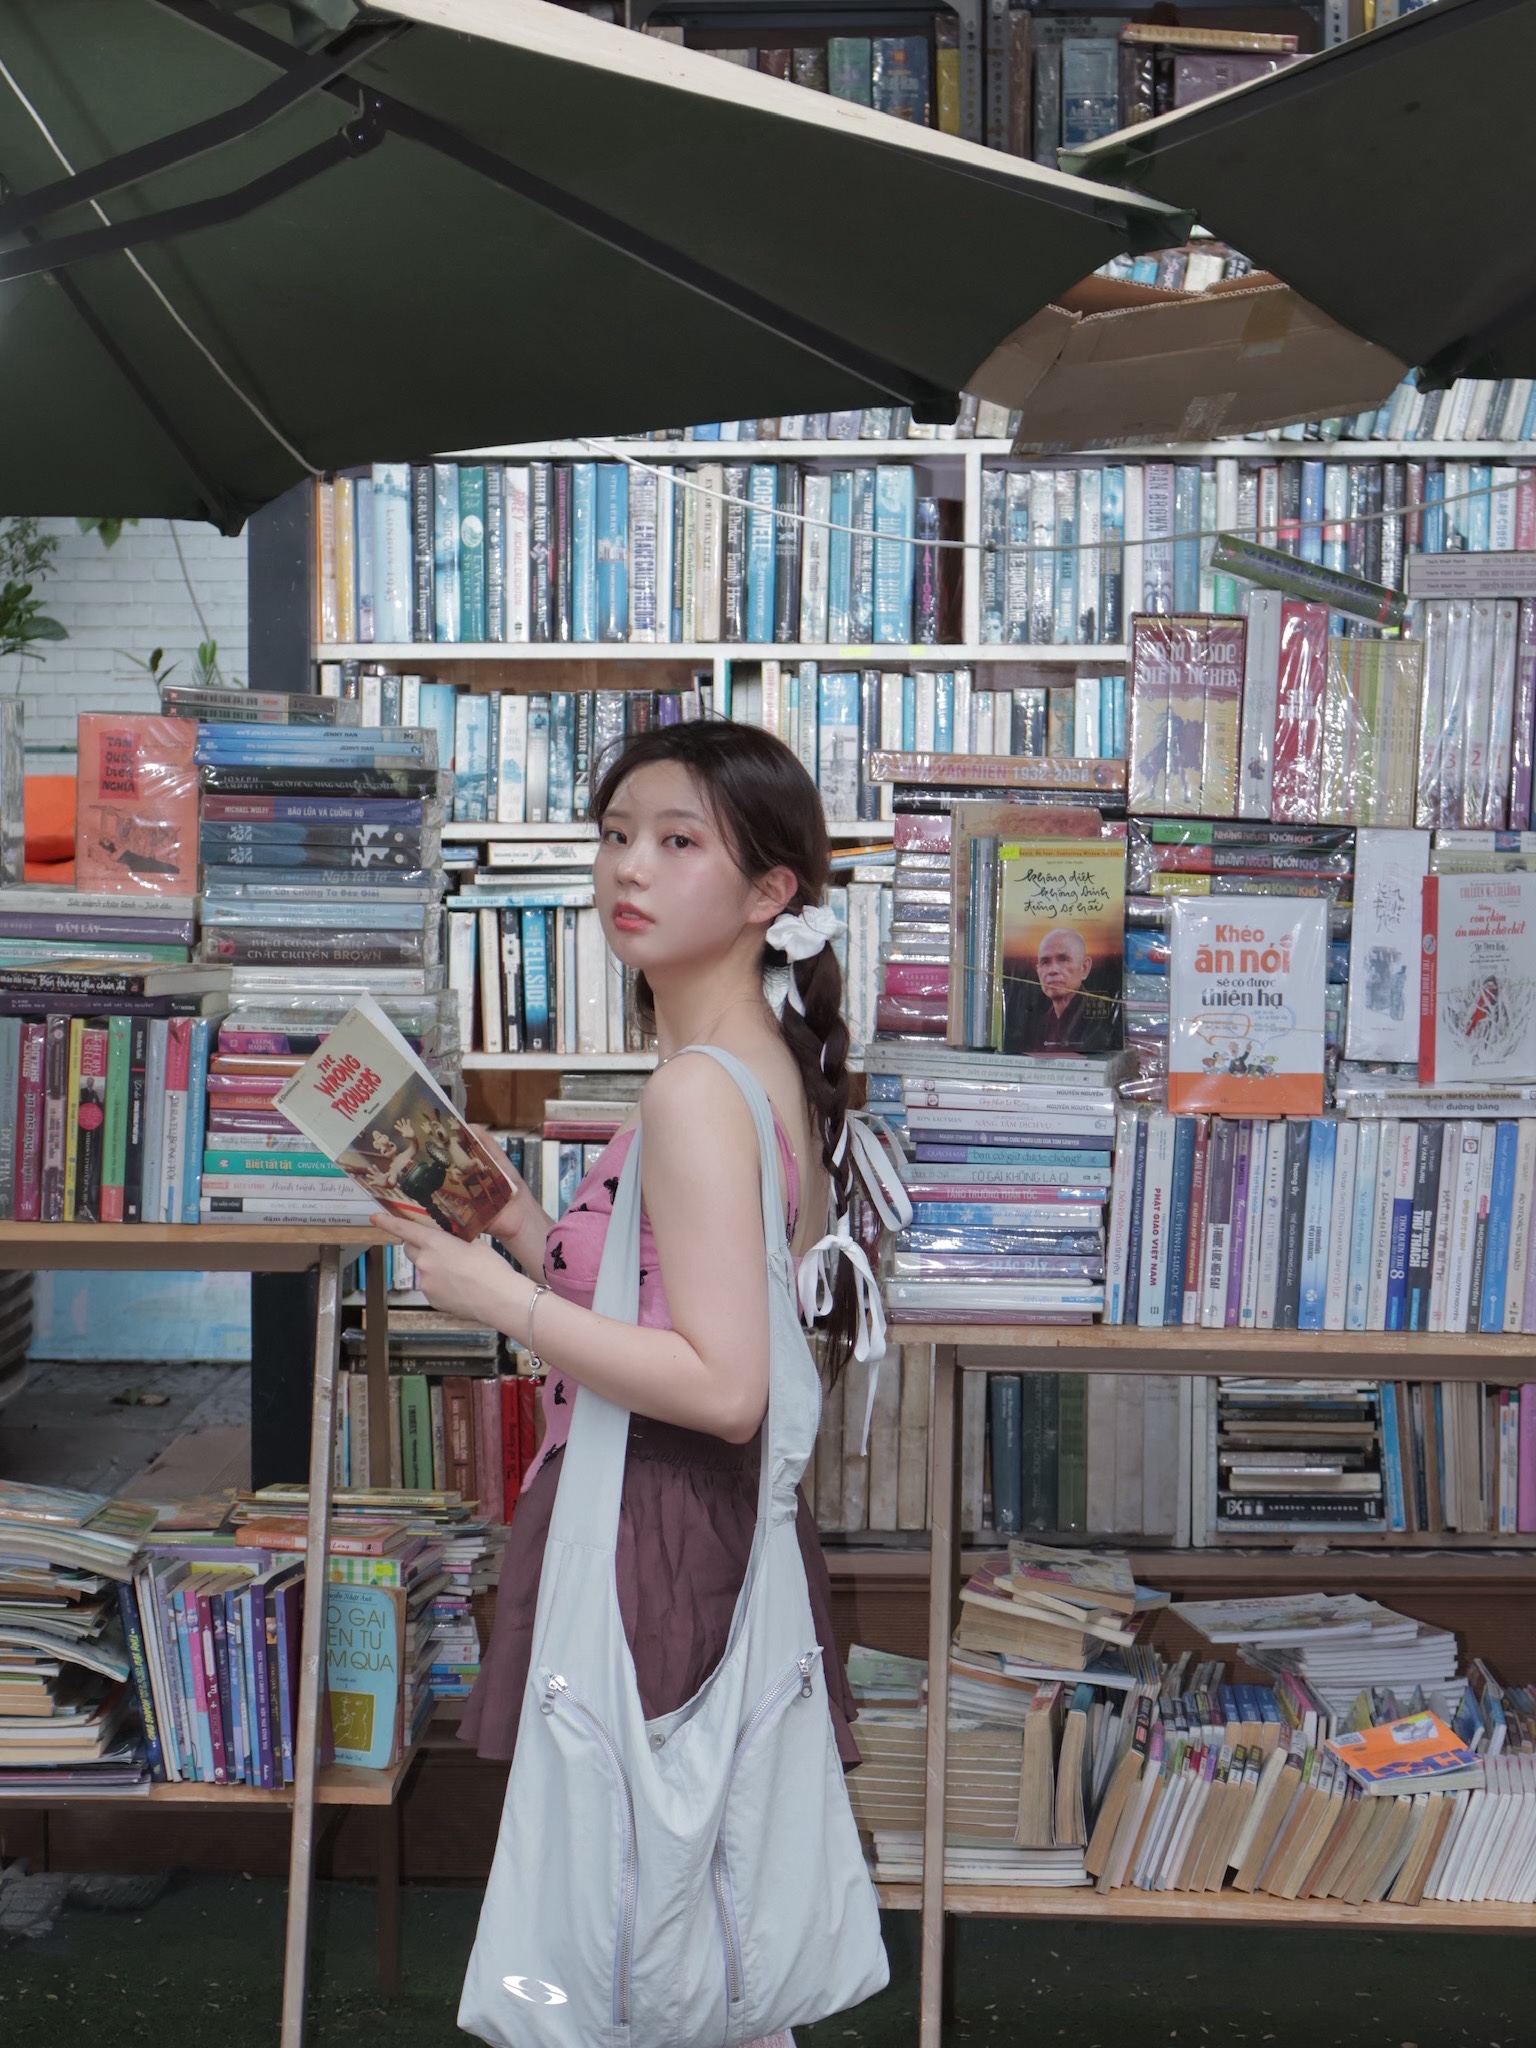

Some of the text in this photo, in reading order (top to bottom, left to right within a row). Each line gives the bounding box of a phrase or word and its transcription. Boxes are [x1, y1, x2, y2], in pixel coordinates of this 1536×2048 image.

[608, 474, 618, 500] STEVE
[1149, 469, 1168, 532] DAN BROWN
[728, 516, 742, 544] Parker
[384, 508, 396, 603] LONDON 1945
[514, 532, 522, 606] MICHAEL CRICHTON
[724, 552, 742, 584] Family
[464, 554, 473, 610] SPENCER
[728, 586, 742, 619] Honor
[756, 571, 764, 617] PREDATOR
[578, 694, 588, 752] BOB MAYER
[1472, 752, 1482, 766] 2
[224, 806, 250, 814] MICHAEL
[1269, 833, 1294, 843] KHỐN
[1214, 854, 1245, 866] NHỮNG
[1272, 857, 1298, 869] KHỐN
[1299, 858, 1318, 870] KHỔ
[322, 870, 348, 883] Ngô
[1014, 868, 1096, 887] không diệt
[1031, 887, 1110, 902] không sinh
[1460, 886, 1488, 898] COLLEEN
[1470, 910, 1506, 924] con chim
[1215, 924, 1264, 943] Khéo
[334, 950, 382, 960] BROWN
[1194, 944, 1290, 974] ăn nói
[526, 938, 544, 1010] FELLSIDE
[1422, 960, 1430, 972] THE
[1246, 978, 1276, 987] được
[1202, 989, 1283, 1010] thiên hạ
[1422, 994, 1430, 1016] BIRDS
[23, 1040, 31, 1078] SIDNEY
[32, 1034, 40, 1082] SHELDON
[316, 1054, 336, 1074] THE
[314, 1054, 362, 1099] WRONG
[330, 1066, 382, 1122] TROUSERS
[932, 1116, 962, 1124] KAUFMAN
[972, 1149, 992, 1161] bạn
[1398, 1135, 1412, 1188] Stephen R. Covey
[972, 1170, 986, 1182] CÔ
[986, 1170, 1004, 1182] GÁI
[1006, 1170, 1041, 1183] KHÔNG
[1042, 1171, 1056, 1183] LÀ
[1419, 1164, 1428, 1184] TRUNG
[309, 1216, 327, 1224] lang
[328, 1216, 352, 1224] thang
[1149, 1188, 1162, 1286] PHẬT GIÁO VIỆT NAM
[1210, 1278, 1222, 1290] SAY
[1390, 1269, 1404, 1280] 8
[348, 1608, 386, 1629] GAI
[362, 1629, 382, 1650] TU
[350, 1653, 394, 1673] QUA
